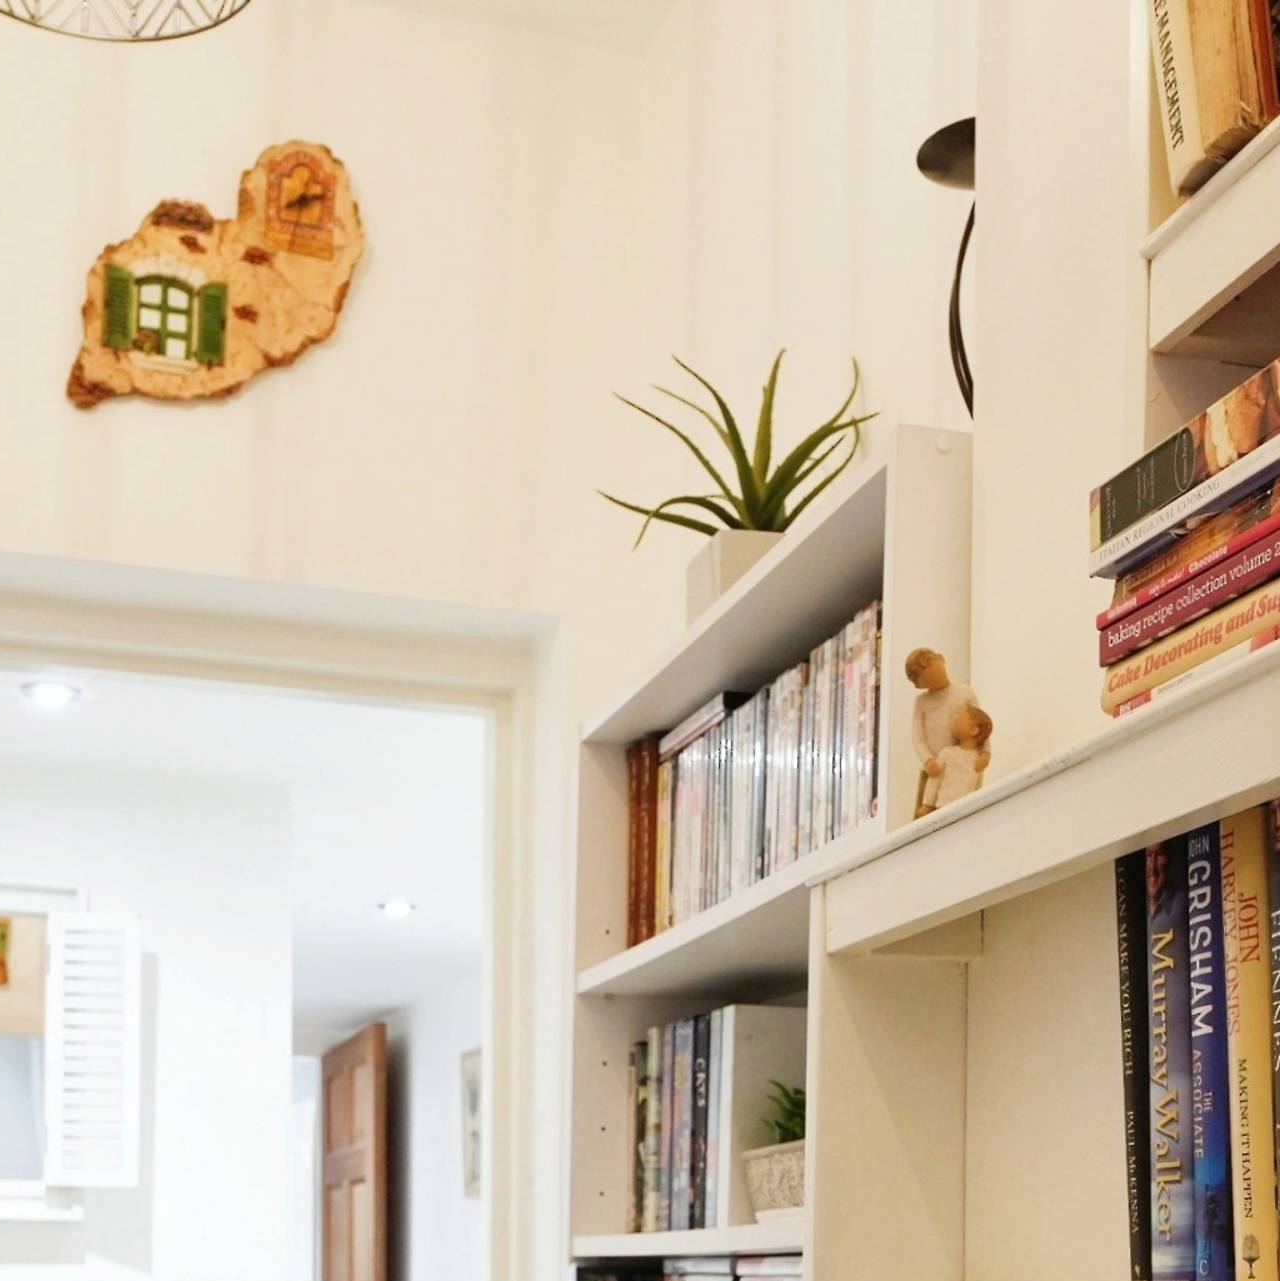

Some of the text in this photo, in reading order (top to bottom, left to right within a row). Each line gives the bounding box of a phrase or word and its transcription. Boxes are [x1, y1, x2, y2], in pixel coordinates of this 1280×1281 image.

[1156, 11, 1184, 150] MANAGEMENT
[1107, 662, 1142, 693] Cake
[1143, 625, 1223, 677] Decorating
[1225, 605, 1256, 632] and
[1108, 618, 1142, 647] baking
[1142, 602, 1174, 630] recipe
[1175, 571, 1228, 611] collection
[1229, 547, 1272, 580] volume
[1188, 860, 1214, 1037] GRISHAM
[1150, 928, 1181, 1242] Murray Walker
